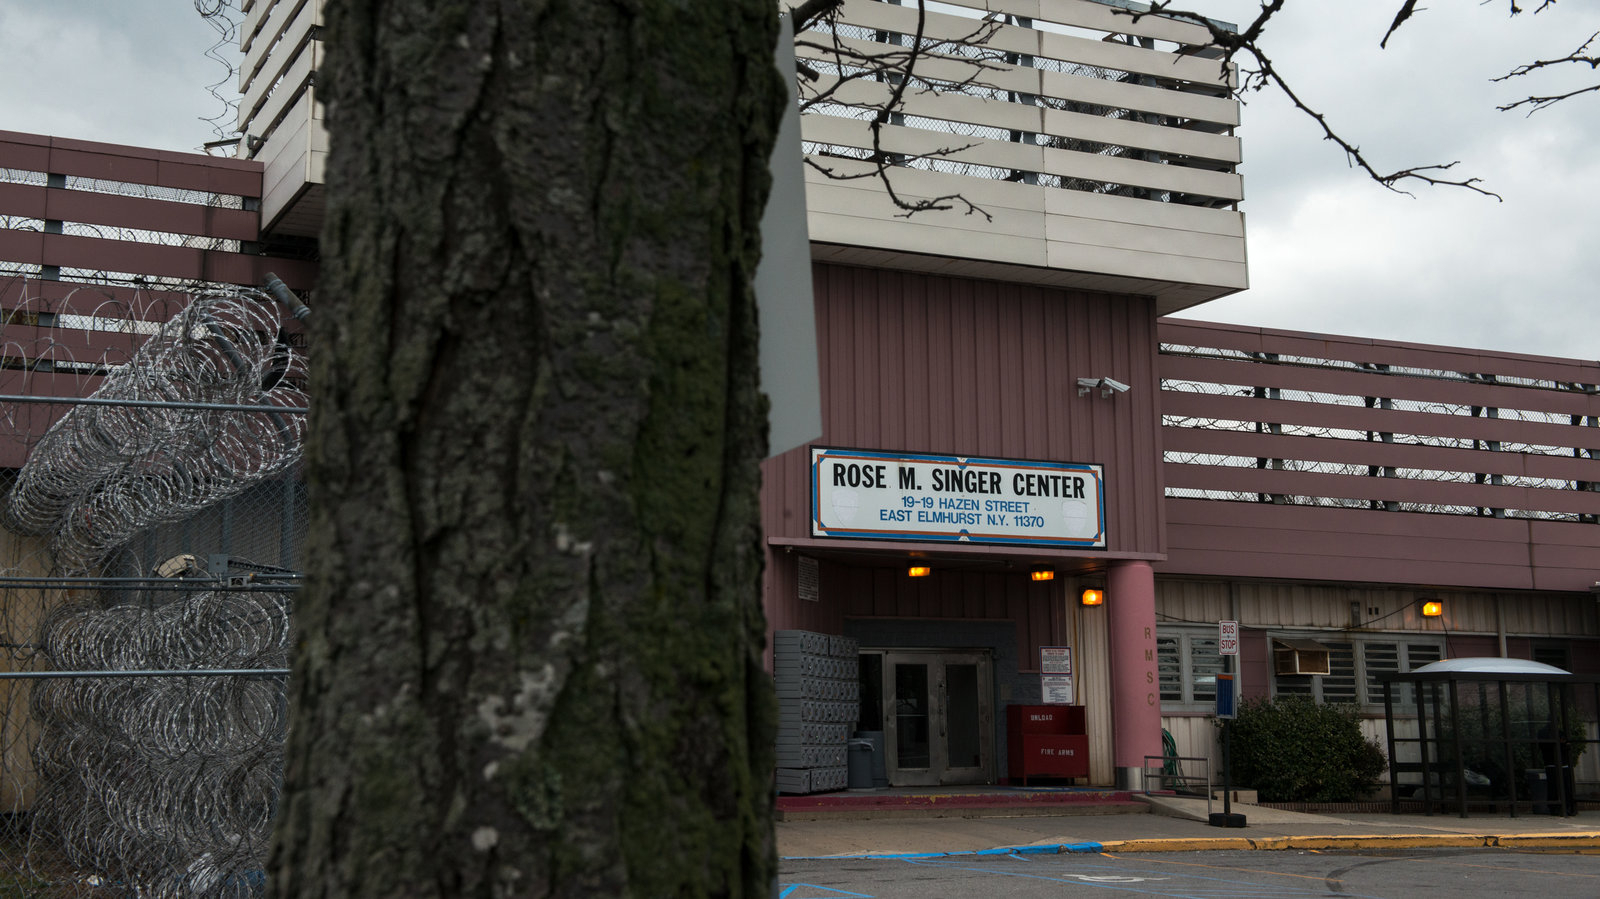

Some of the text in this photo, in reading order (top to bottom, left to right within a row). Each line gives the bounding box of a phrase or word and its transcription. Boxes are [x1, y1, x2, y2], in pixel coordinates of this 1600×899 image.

[833, 463, 1085, 499] ROSE M. SINGER CENTER
[901, 496, 1030, 513] 19-19 HAZEN STREET
[880, 509, 1044, 527] EAST ELMHURST N.Y. 11370
[1222, 625, 1235, 634] BUS
[1221, 640, 1236, 649] STOP
